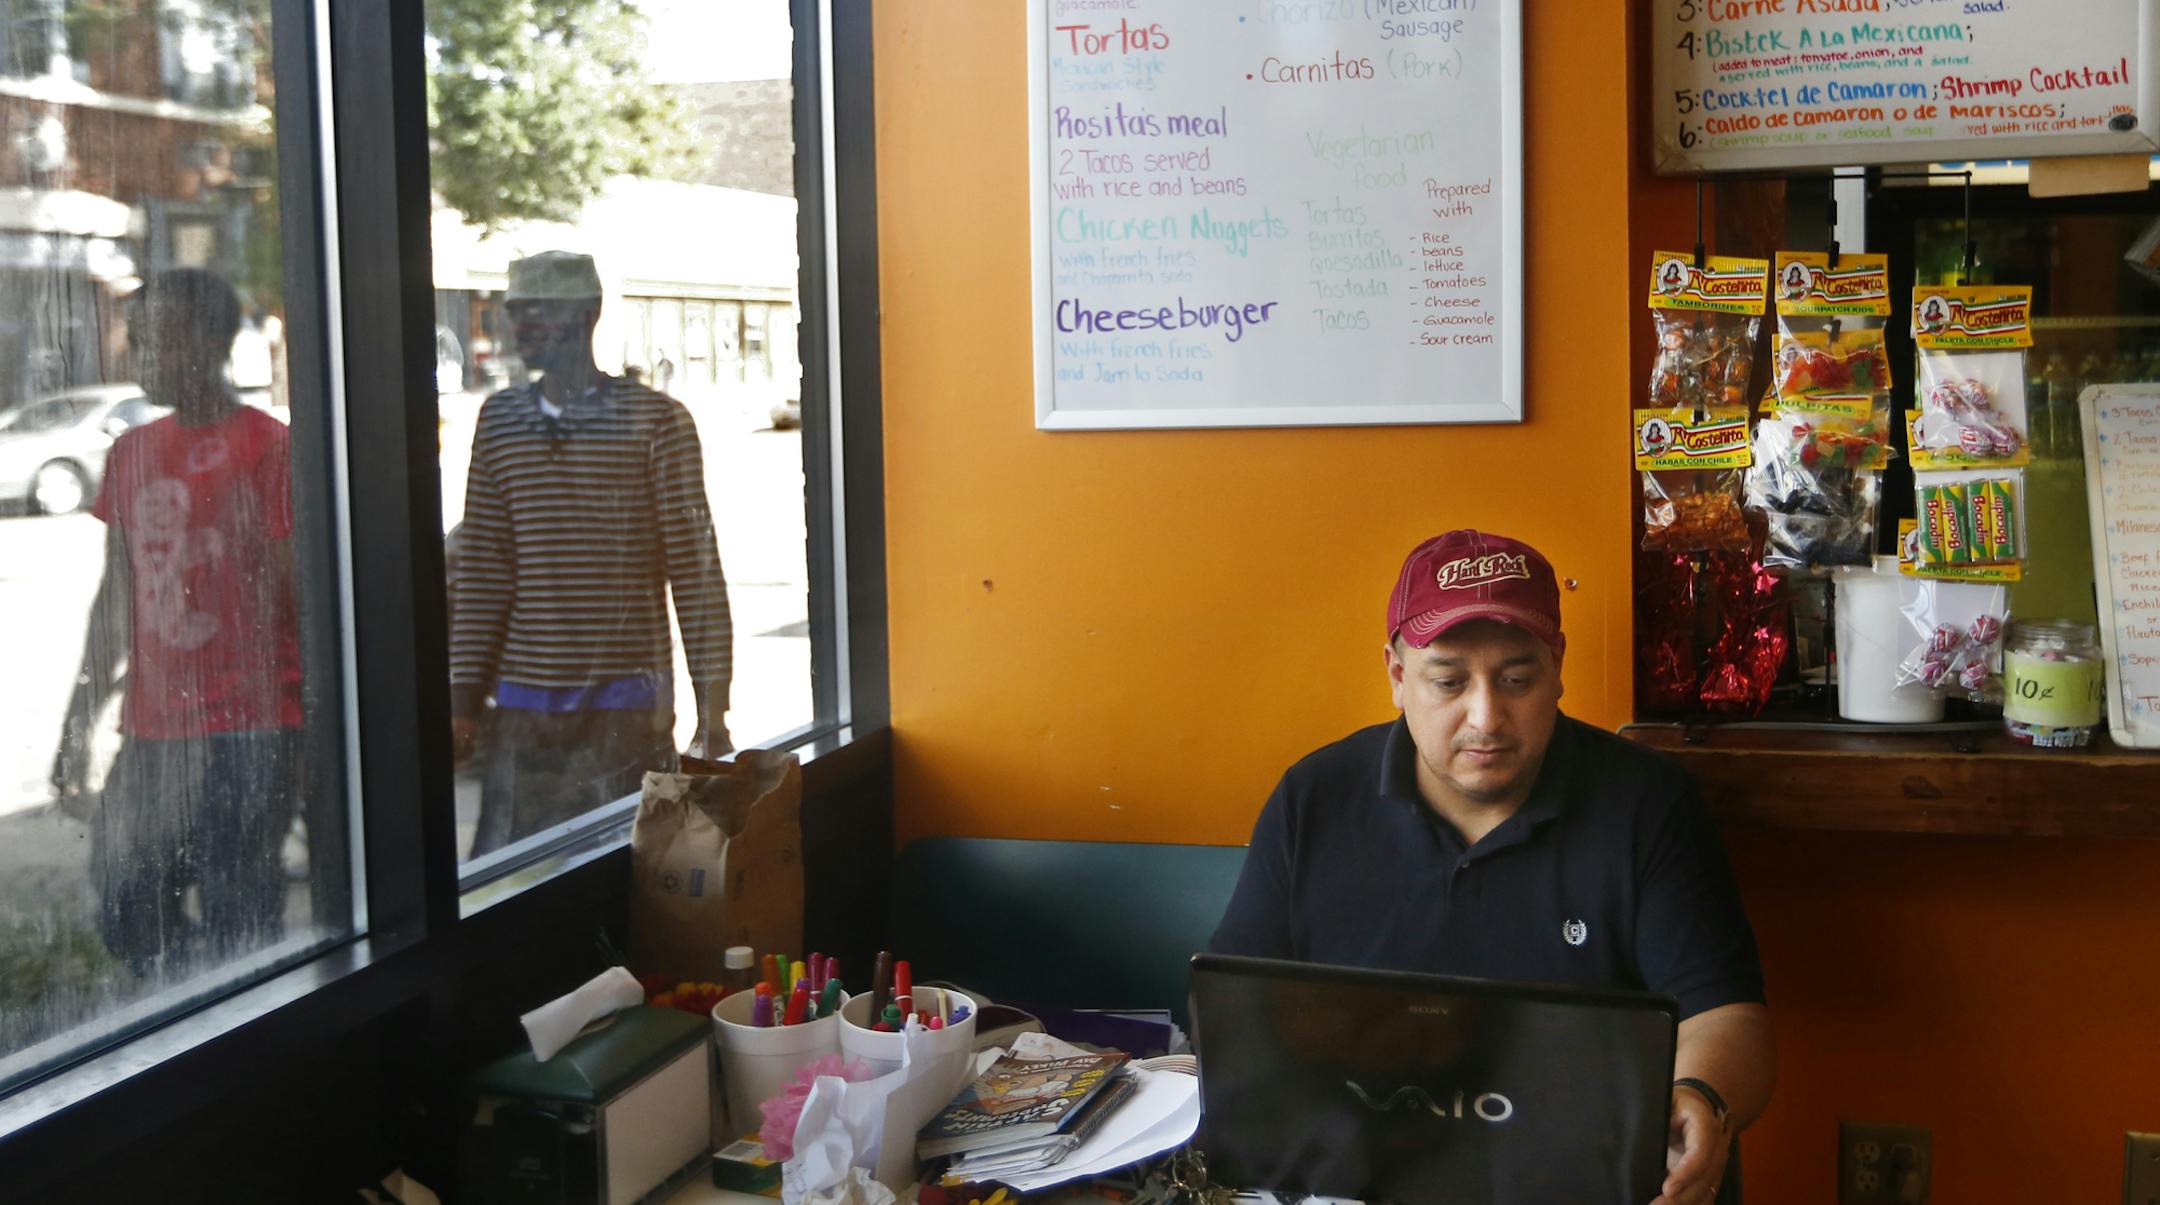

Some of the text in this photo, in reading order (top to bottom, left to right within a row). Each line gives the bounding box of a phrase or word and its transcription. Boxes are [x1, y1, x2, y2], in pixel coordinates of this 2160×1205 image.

[1707, 0, 1785, 22] Carne
[1055, 18, 1170, 55] Tortas
[1380, 16, 1464, 42] Sausage
[1800, 27, 1813, 49] A
[1820, 30, 1845, 48] La
[1899, 46, 1923, 56] and
[1261, 48, 1463, 83] Carnitas (Pork)
[1775, 65, 1803, 76] with
[1884, 57, 1908, 68] and
[1703, 82, 1788, 112] Cocktel
[1797, 85, 1821, 105] de
[1940, 75, 2023, 100] Shrimp
[2030, 57, 2129, 93] Cocktail
[1168, 105, 1228, 138] meal
[1705, 113, 1761, 135] Caldo
[1765, 116, 1788, 129] de
[1793, 108, 1883, 127] Camaron
[1913, 105, 1937, 118] de
[1992, 122, 2020, 134] with
[2052, 118, 2076, 130] and
[1305, 124, 1436, 170] Vegetarian
[1059, 147, 1211, 175] 2 Tacos served
[1053, 176, 1248, 199] with rice and beans
[1423, 177, 1492, 202] Prepared
[1301, 196, 1367, 226] Tortas
[1433, 201, 1473, 218] with
[1057, 207, 1289, 257] Chicken Nuggets
[1422, 232, 1450, 244] Rice
[1422, 246, 1464, 257] beans
[1423, 260, 1464, 272] lettuce
[1422, 274, 1487, 290] Tomatoes
[1424, 296, 1481, 308] Cheese
[1056, 297, 1278, 343] Cheeseburger
[1312, 309, 1371, 335] Tacos
[1423, 312, 1495, 327] Guacamole
[1420, 332, 1493, 345] Sour cream
[1057, 365, 1084, 381] and
[1437, 553, 1527, 587] Hard Rock
[1408, 1004, 1450, 1015] SONY
[1346, 1080, 1513, 1122] VAIO
